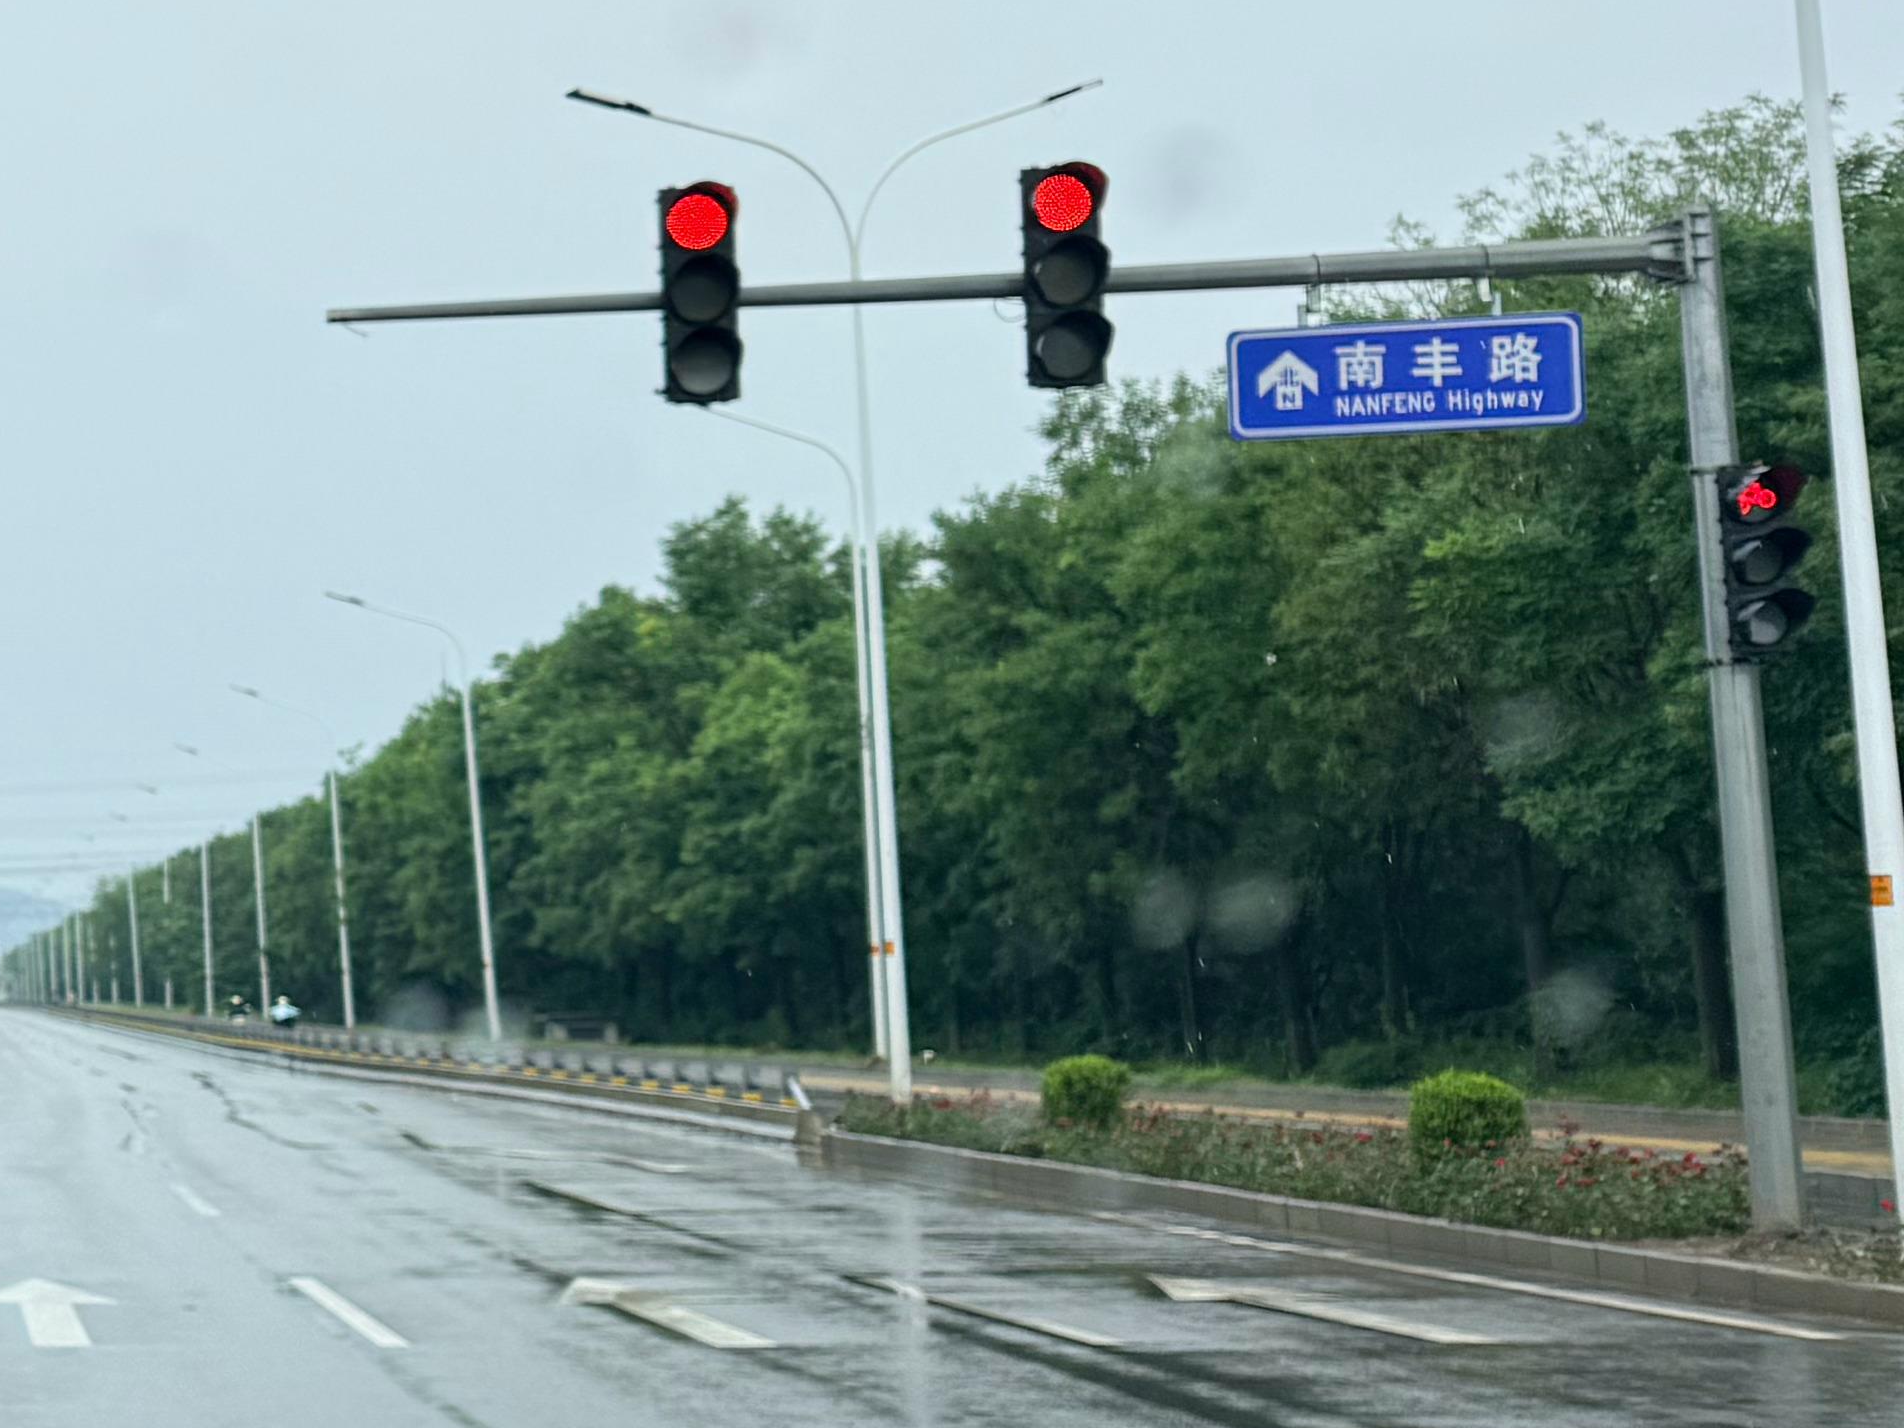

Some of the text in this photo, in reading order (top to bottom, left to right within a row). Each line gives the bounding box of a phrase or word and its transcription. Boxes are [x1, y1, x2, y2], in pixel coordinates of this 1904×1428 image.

[1334, 333, 1542, 390] 南丰路
[1336, 388, 1543, 417] NANFENG Highway
